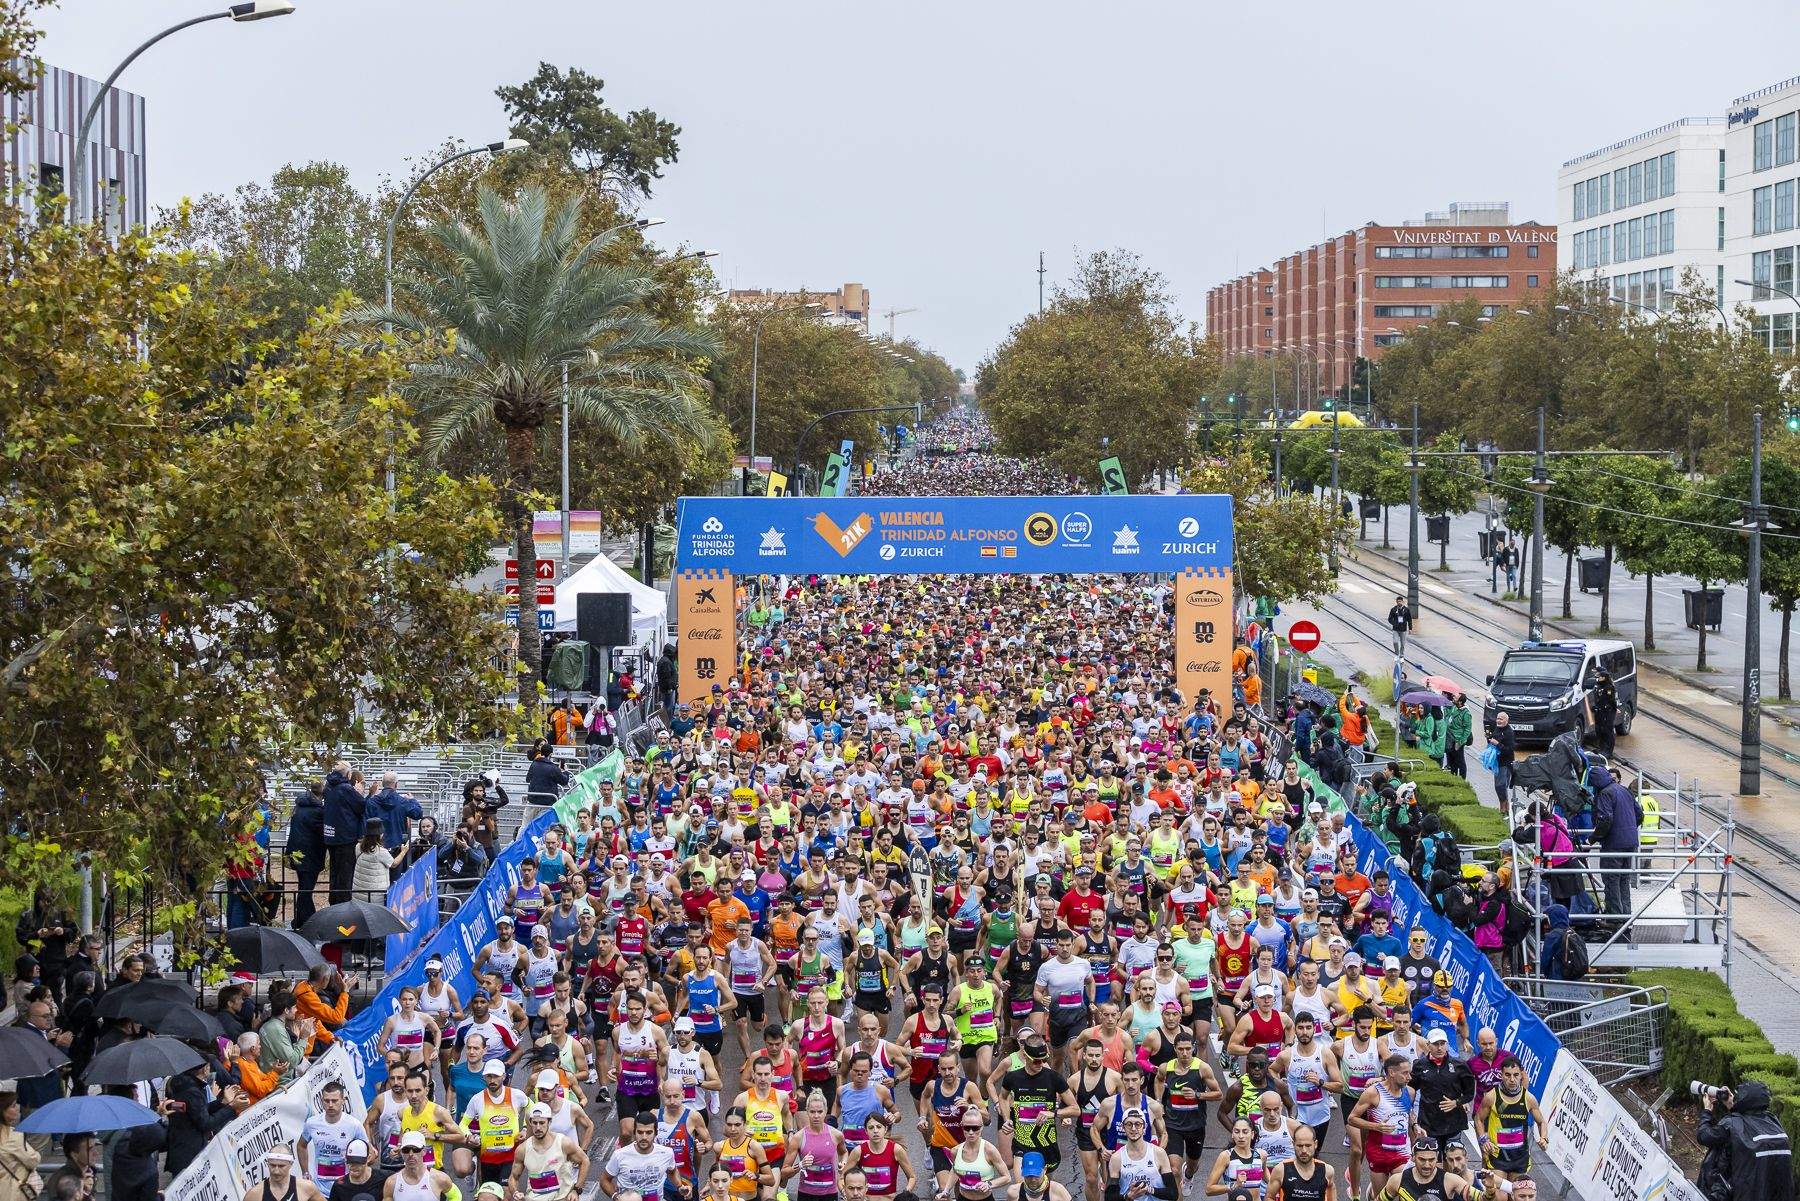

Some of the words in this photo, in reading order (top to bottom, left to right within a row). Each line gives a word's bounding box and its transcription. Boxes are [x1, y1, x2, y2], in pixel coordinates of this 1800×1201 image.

[842, 448, 852, 468] 3
[824, 463, 840, 489] 2
[880, 511, 945, 526] VALENCIA
[692, 532, 735, 540] FUNDACIÓN
[840, 521, 867, 551] 21K
[880, 529, 946, 542] TRINIDAD
[950, 529, 1018, 542] ALFONSO
[692, 540, 735, 548] TRINIDAD
[1162, 542, 1217, 554] ZURICH
[692, 548, 735, 556] ALFONSO
[758, 547, 787, 556] luanvi
[900, 547, 943, 557] ZURICH
[1112, 546, 1140, 555] luanvi
[689, 606, 721, 614] CaixaBank
[540, 613, 554, 627] 14
[1513, 1038, 1543, 1087] ZURICH
